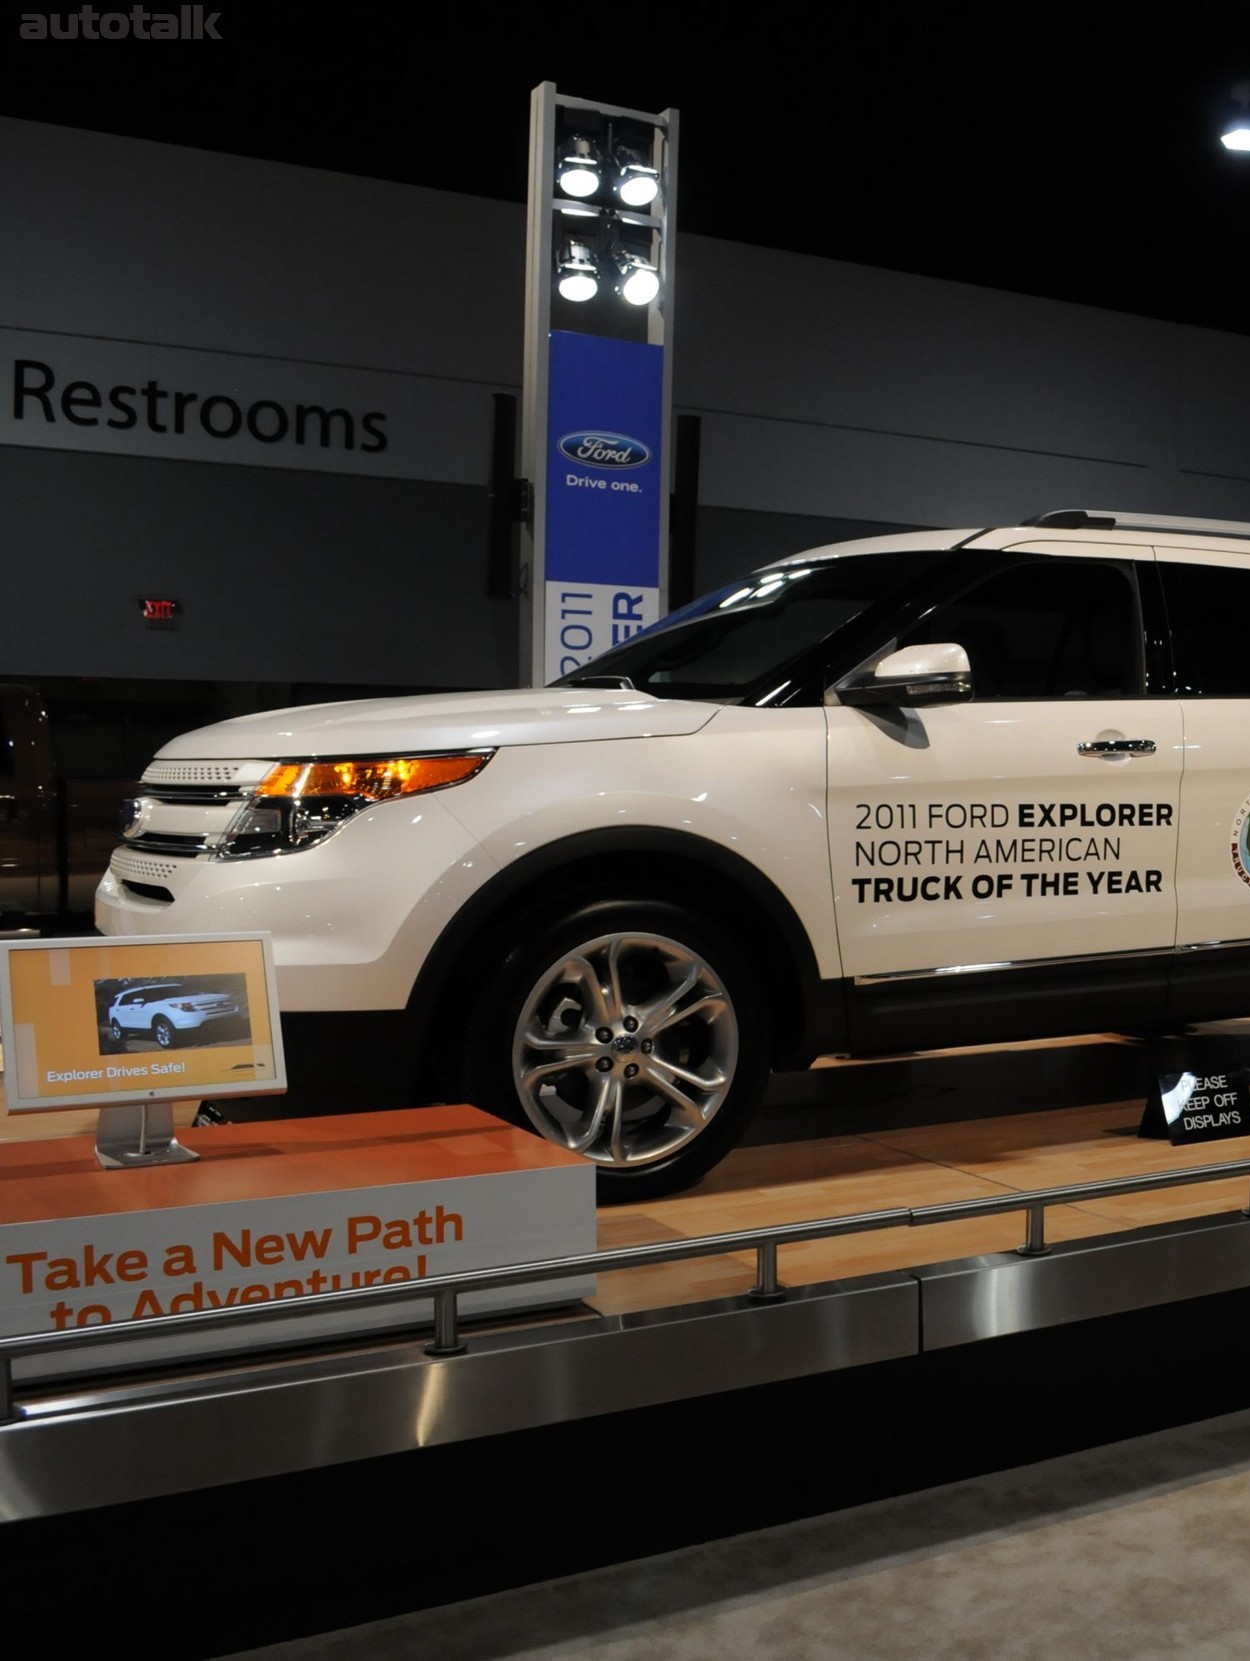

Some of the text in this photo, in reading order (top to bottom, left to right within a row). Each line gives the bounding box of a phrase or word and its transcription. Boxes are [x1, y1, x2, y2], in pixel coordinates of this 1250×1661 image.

[13, 359, 388, 454] Restrooms
[577, 436, 632, 464] Ford
[566, 474, 643, 493] Drive one.
[855, 803, 1174, 830] 2011 FORD EXPLORER
[855, 837, 1121, 867] NORTH AMERICAN
[852, 869, 1163, 904] TRUCK OF THE YEAR
[47, 1062, 186, 1083] Explorer Drives Safe!
[1214, 1092, 1238, 1108] OFF
[1183, 1110, 1242, 1131] DISPLAYS
[6, 1205, 465, 1295] Take a New Path
[50, 1300, 112, 1331] to
